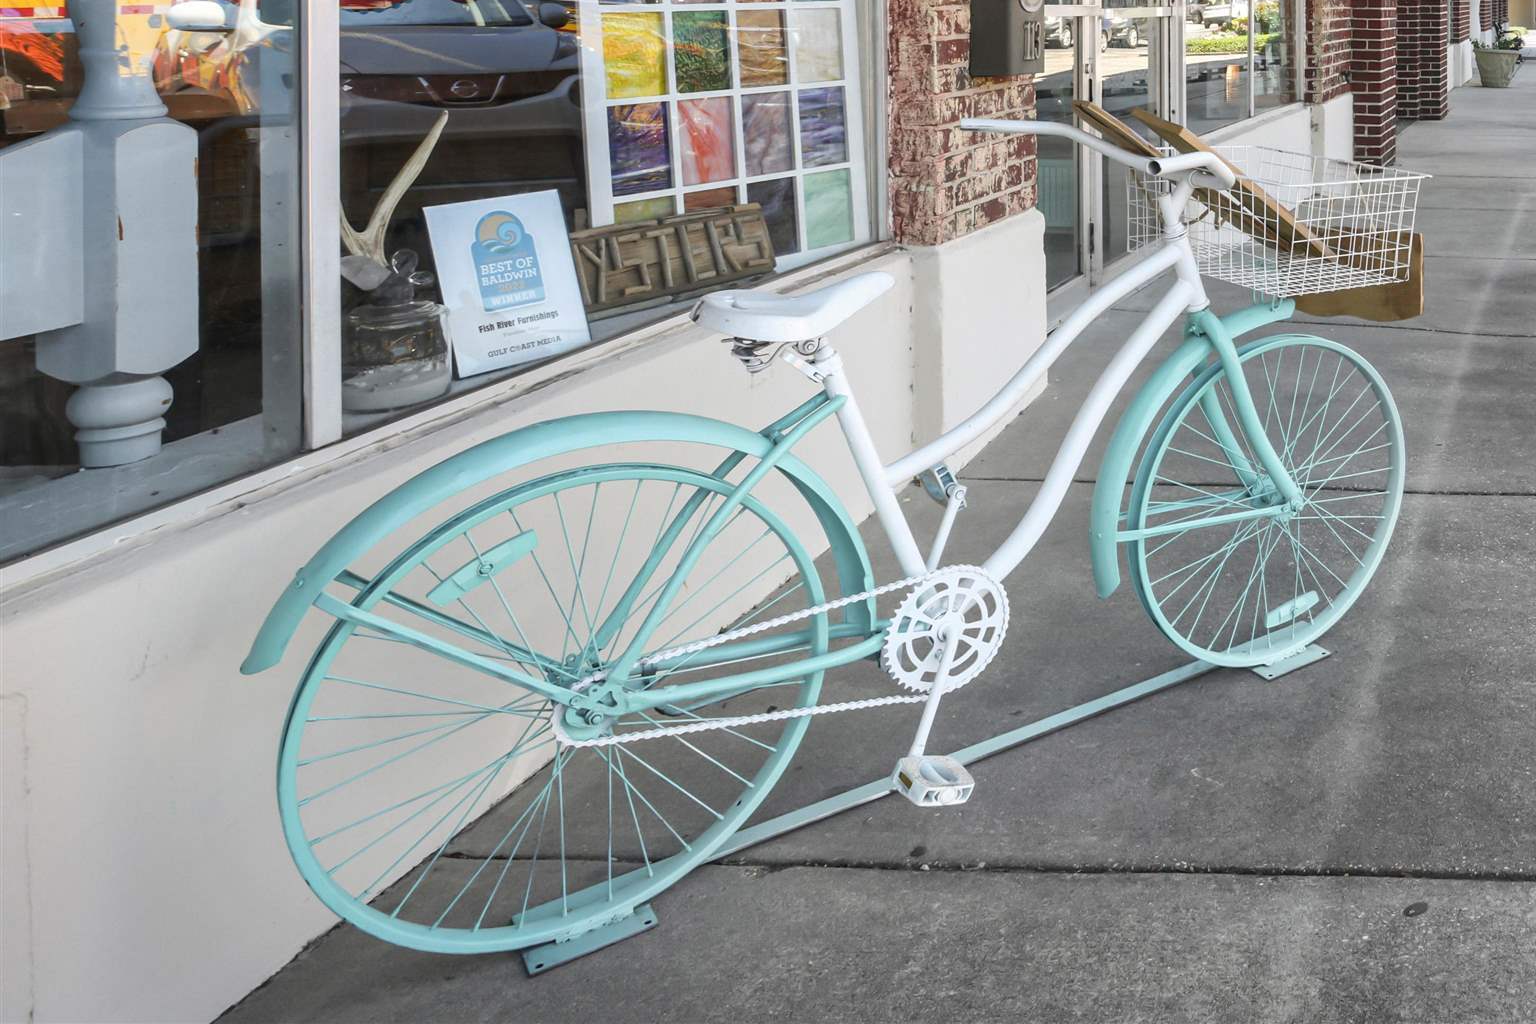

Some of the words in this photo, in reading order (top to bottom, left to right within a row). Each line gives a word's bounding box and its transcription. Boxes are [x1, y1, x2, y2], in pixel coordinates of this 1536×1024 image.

[1023, 20, 1041, 61] 113
[480, 260, 513, 276] BEST
[515, 256, 534, 269] OF
[481, 267, 537, 287] BALDWIN
[490, 289, 536, 306] WINNER
[478, 323, 495, 334] Fish
[496, 318, 516, 330] River
[517, 310, 559, 325] Furnishings
[487, 347, 509, 358] GULF
[509, 341, 536, 354] COAST
[536, 334, 562, 347] MEDIA
